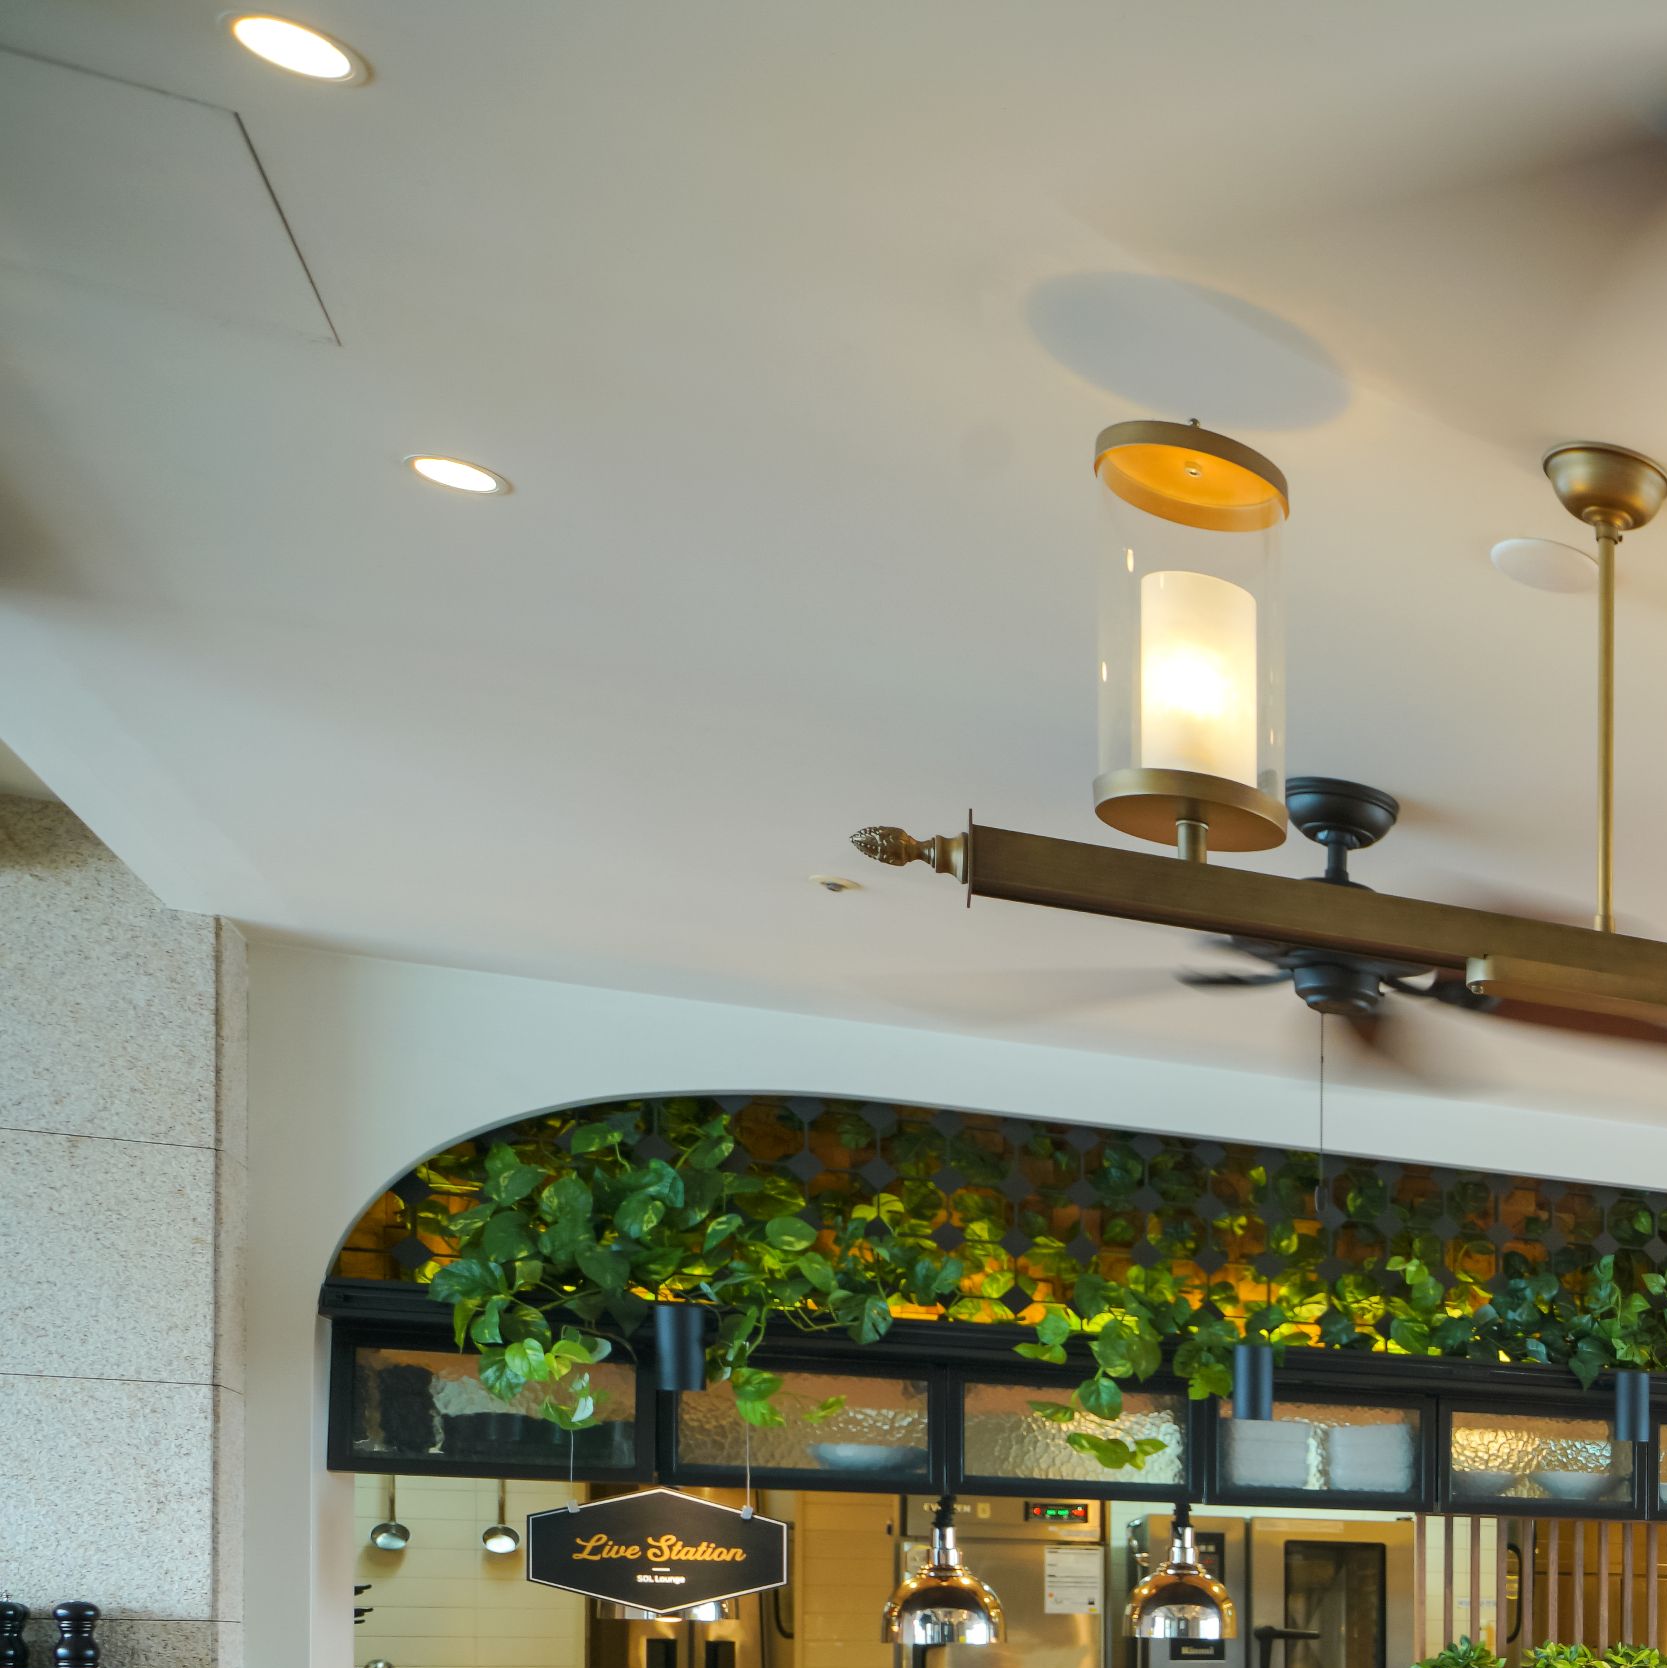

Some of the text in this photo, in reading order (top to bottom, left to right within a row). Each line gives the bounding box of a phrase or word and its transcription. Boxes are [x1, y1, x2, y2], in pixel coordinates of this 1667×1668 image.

[572, 1534, 746, 1562] Live Station
[636, 1574, 686, 1585] SOL Lounge
